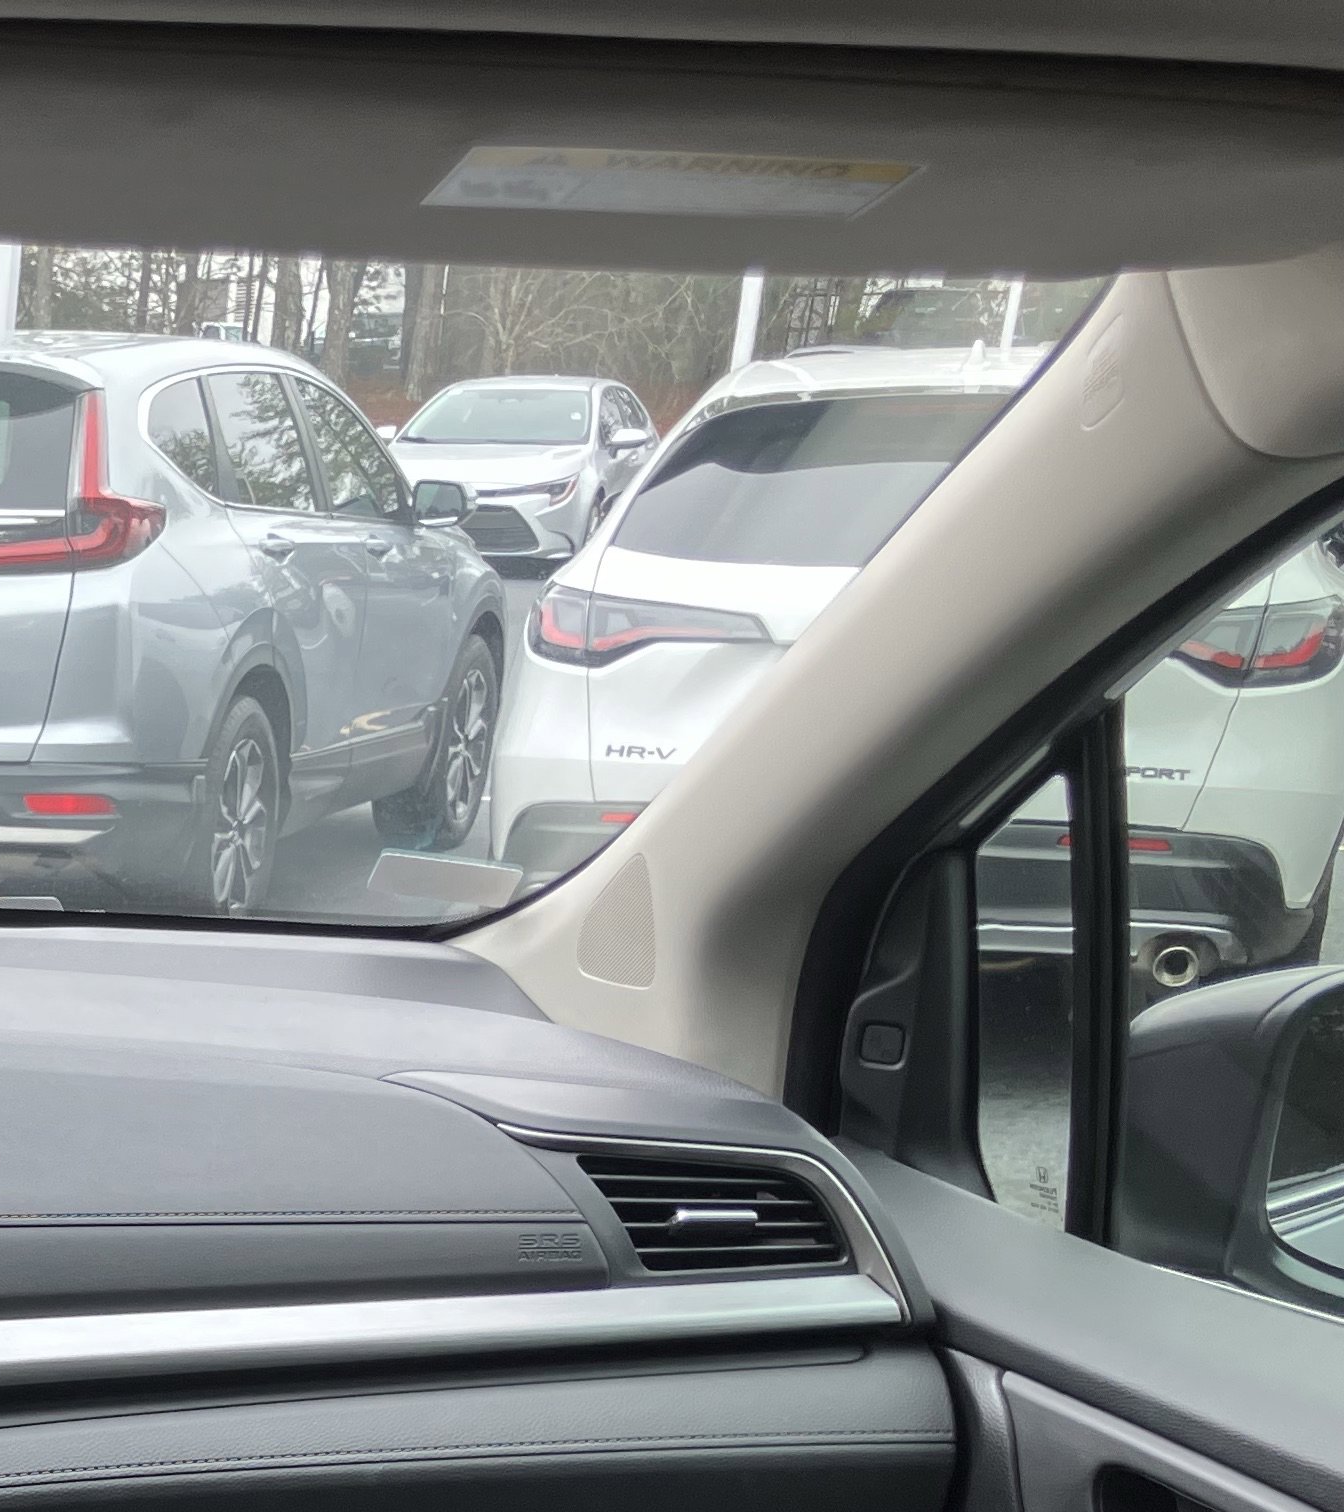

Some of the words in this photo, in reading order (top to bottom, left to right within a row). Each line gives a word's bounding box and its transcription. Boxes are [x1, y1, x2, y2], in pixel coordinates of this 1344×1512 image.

[605, 744, 677, 760] HR-V
[1125, 766, 1191, 780] PORT
[518, 1233, 581, 1248] SRS
